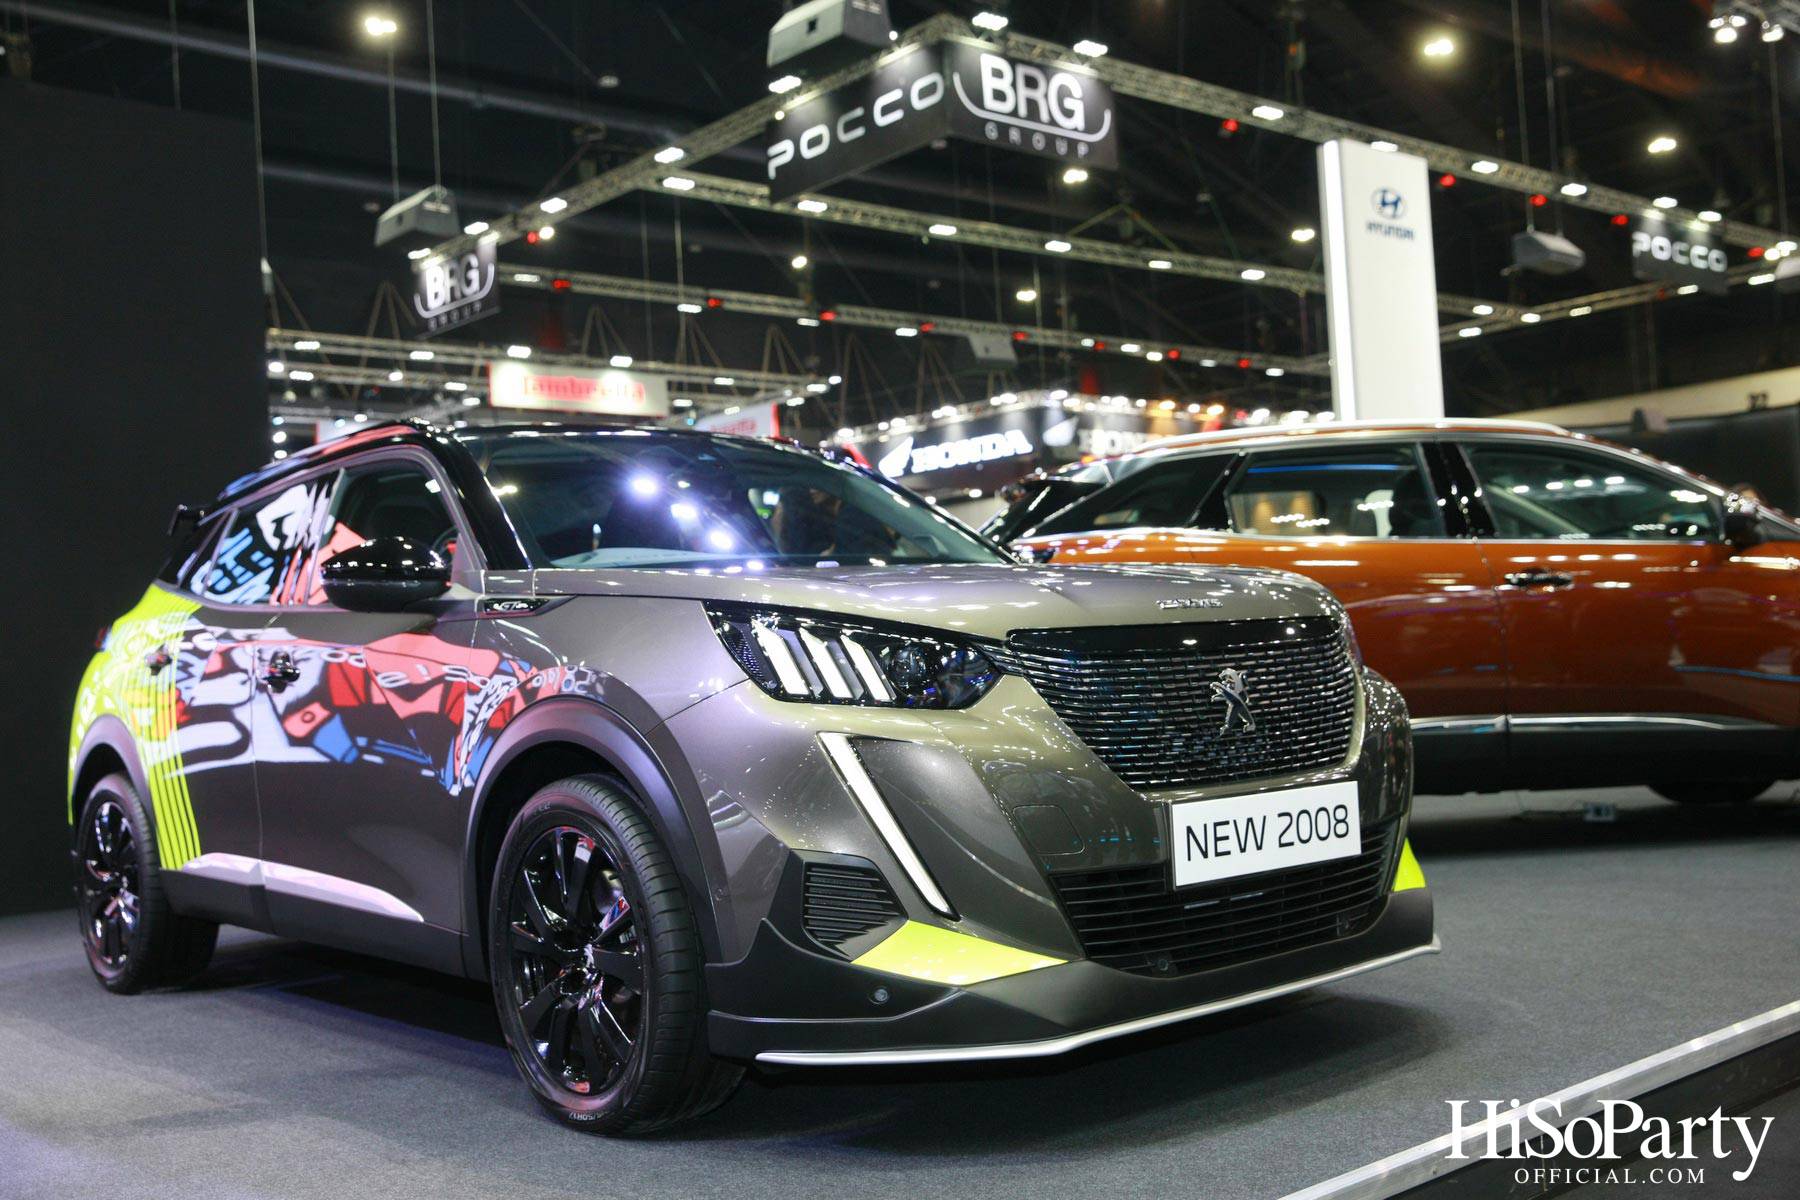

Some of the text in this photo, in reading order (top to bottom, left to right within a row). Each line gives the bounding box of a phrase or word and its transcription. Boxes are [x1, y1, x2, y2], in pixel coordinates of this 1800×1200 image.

[980, 53, 1085, 131] BRG
[767, 72, 945, 180] POCCO
[984, 121, 1089, 159] GROUP
[1632, 231, 1728, 272] POCCO
[425, 253, 480, 311] BRG
[910, 429, 1033, 474] HONDA
[1186, 804, 1349, 862] NEW 2008
